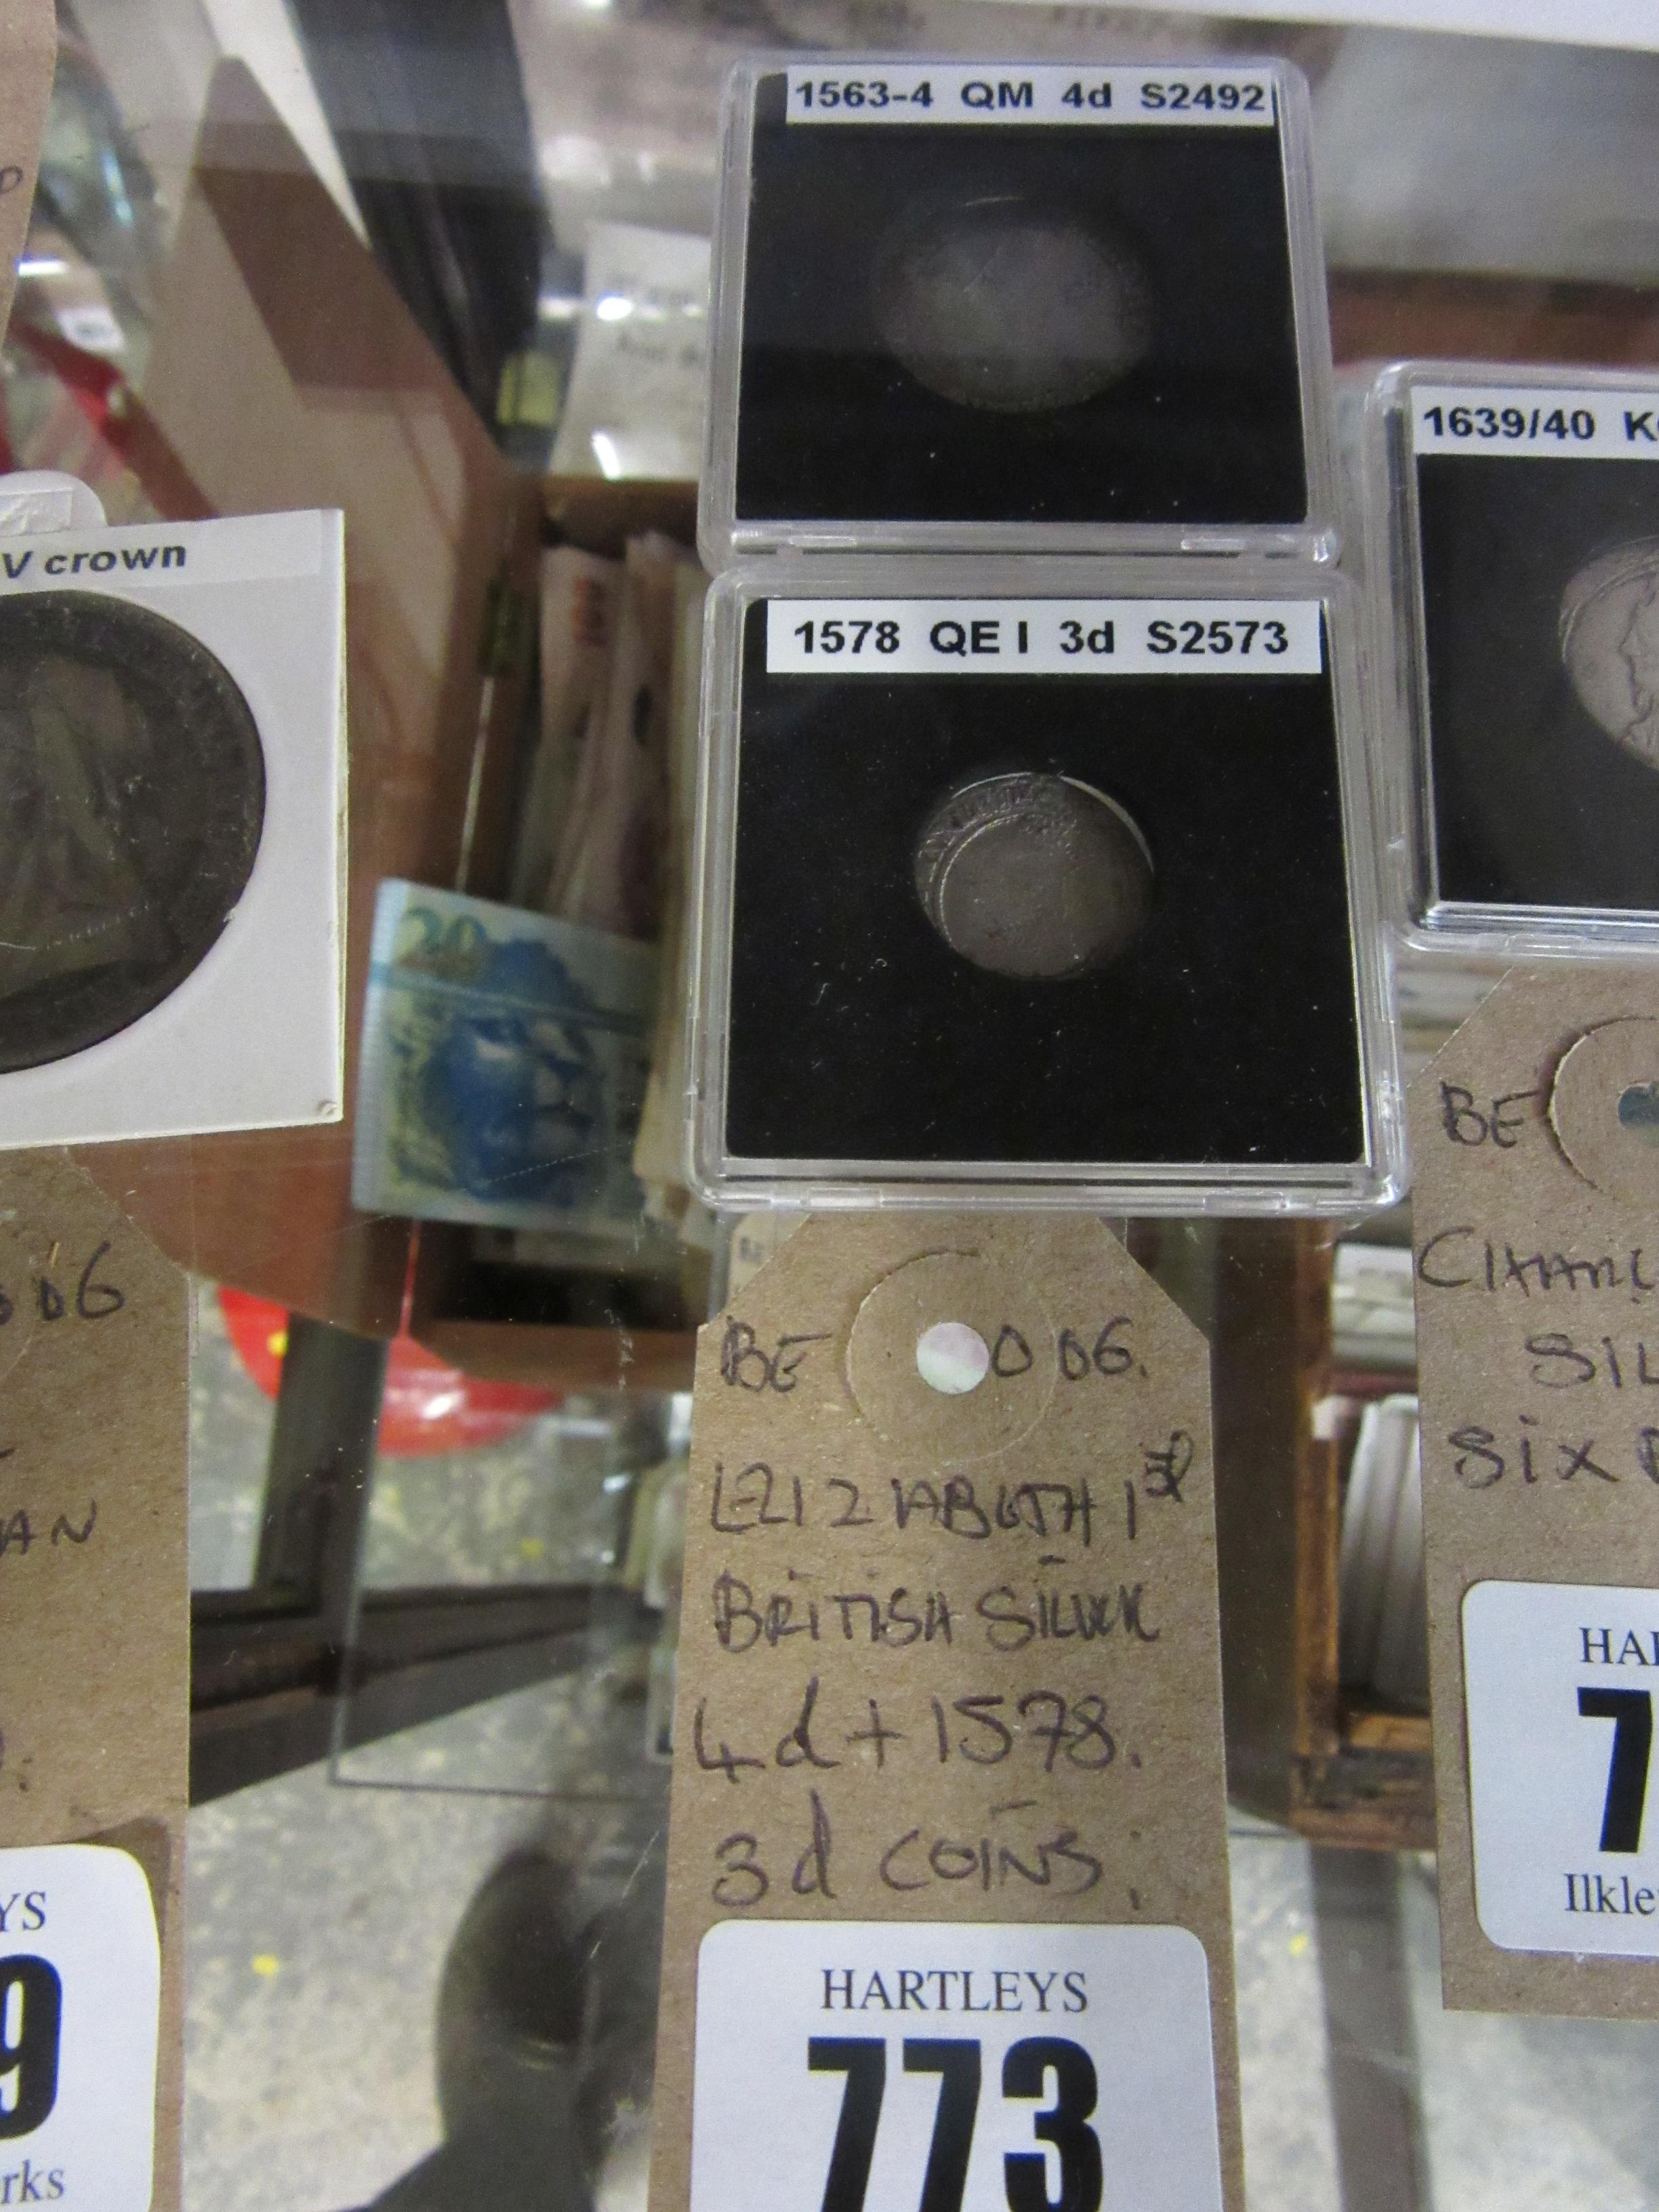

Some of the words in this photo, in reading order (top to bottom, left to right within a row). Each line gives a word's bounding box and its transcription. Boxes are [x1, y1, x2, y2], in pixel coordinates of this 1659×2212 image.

[794, 80, 935, 109] 1563-4
[960, 81, 1034, 110] QM
[1061, 81, 1113, 110] 4d
[1140, 83, 1267, 112] S2492
[1423, 406, 1595, 441] 1639/40
[1623, 411, 1659, 442] K
[44, 544, 187, 575] crown
[794, 619, 901, 655] 1578
[928, 619, 1002, 657] QE
[1059, 619, 1115, 655] 3d
[1146, 619, 1290, 655] S2573
[1578, 1626, 1659, 1666] HA
[1576, 1685, 1653, 1855] 7
[1563, 1872, 1659, 1916] Ilkle
[819, 1968, 1089, 2014] HARTLEYS
[806, 2036, 1104, 2212] 773
